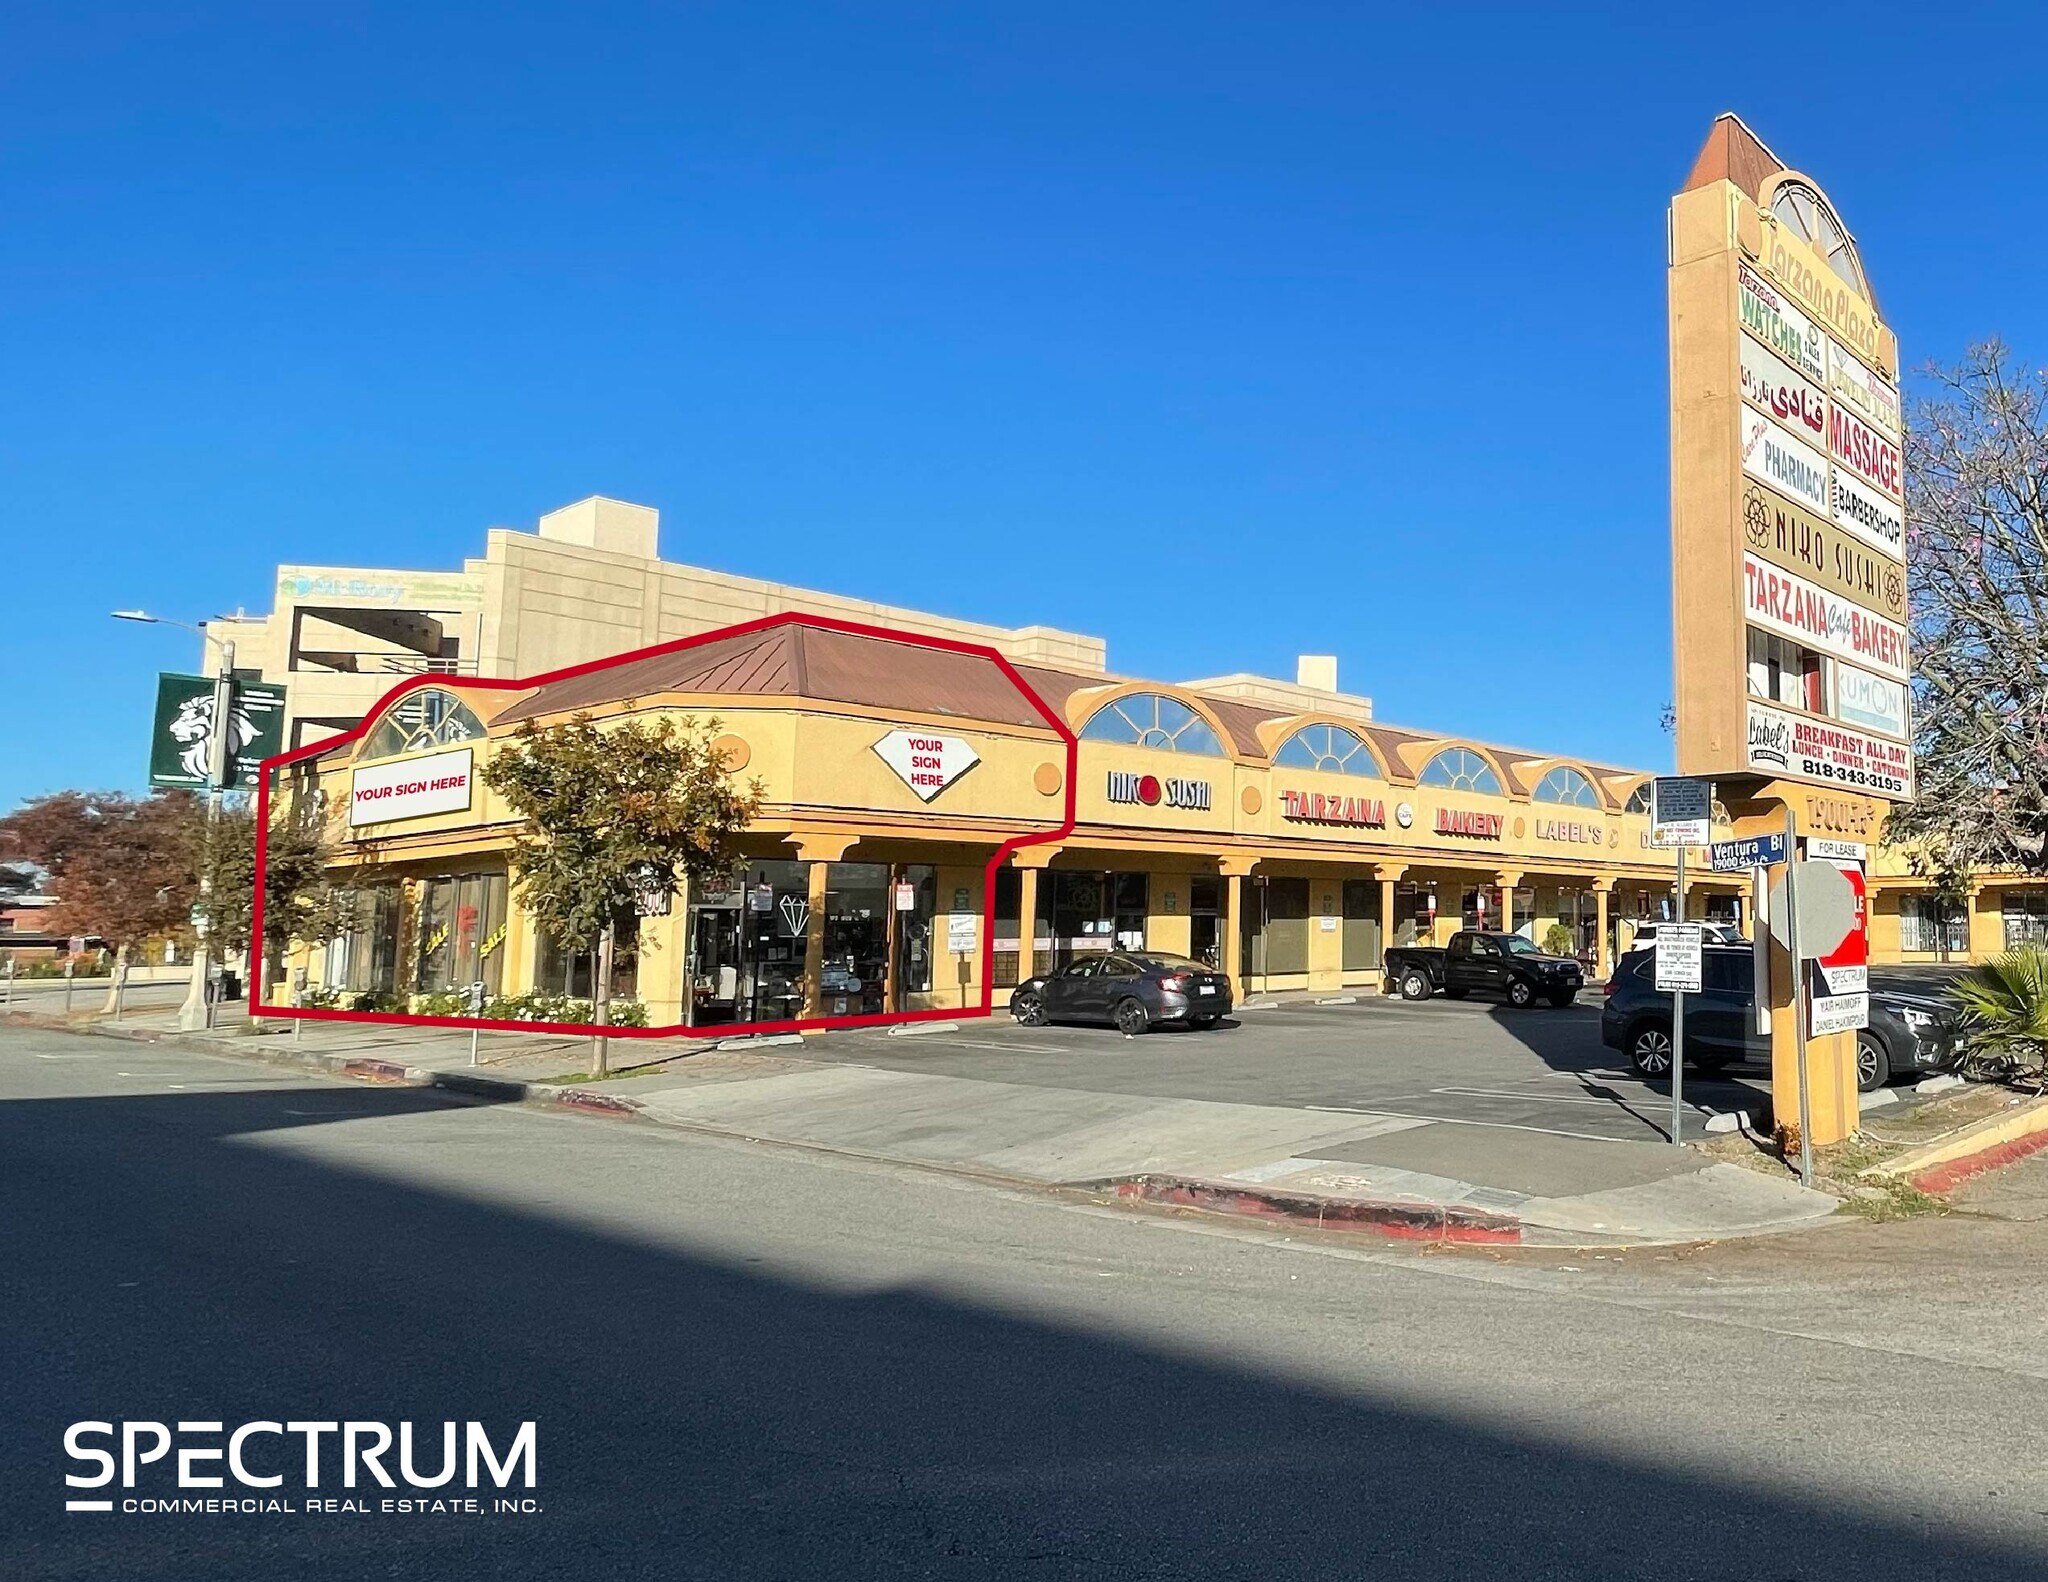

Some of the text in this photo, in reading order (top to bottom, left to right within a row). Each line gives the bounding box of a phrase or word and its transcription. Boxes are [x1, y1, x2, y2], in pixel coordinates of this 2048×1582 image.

[1768, 225, 1875, 356] Tarzana Plaza
[1741, 286, 1802, 365] WATCHES
[1830, 405, 1900, 495] MASSAGE
[1765, 439, 1827, 506] PHARMACY
[1838, 484, 1901, 545] BARBERSHOP
[1776, 508, 1881, 599] NIKO SUSHI
[1745, 561, 1829, 639] TARZANA
[1851, 610, 1905, 669] BAKERY
[1840, 673, 1898, 714] KUMON
[1792, 740, 1823, 759] LUNCH
[1833, 751, 1864, 769] DINNER
[1872, 760, 1909, 780] CATERING
[1795, 722, 1907, 764] BREAKFAST ALL DAY
[1165, 778, 1211, 811] SUSHI
[1281, 790, 1386, 829] TARZANA
[1435, 807, 1504, 841] BAKERY
[1536, 818, 1602, 845] LABEL'S
[1713, 841, 1758, 859] Ventura
[1771, 834, 1783, 852] Bl
[1713, 856, 1738, 870] 19000
[1819, 842, 1857, 857] FOR LEASE
[480, 923, 507, 959] SALE
[1831, 968, 1866, 985] SPECTRUM
